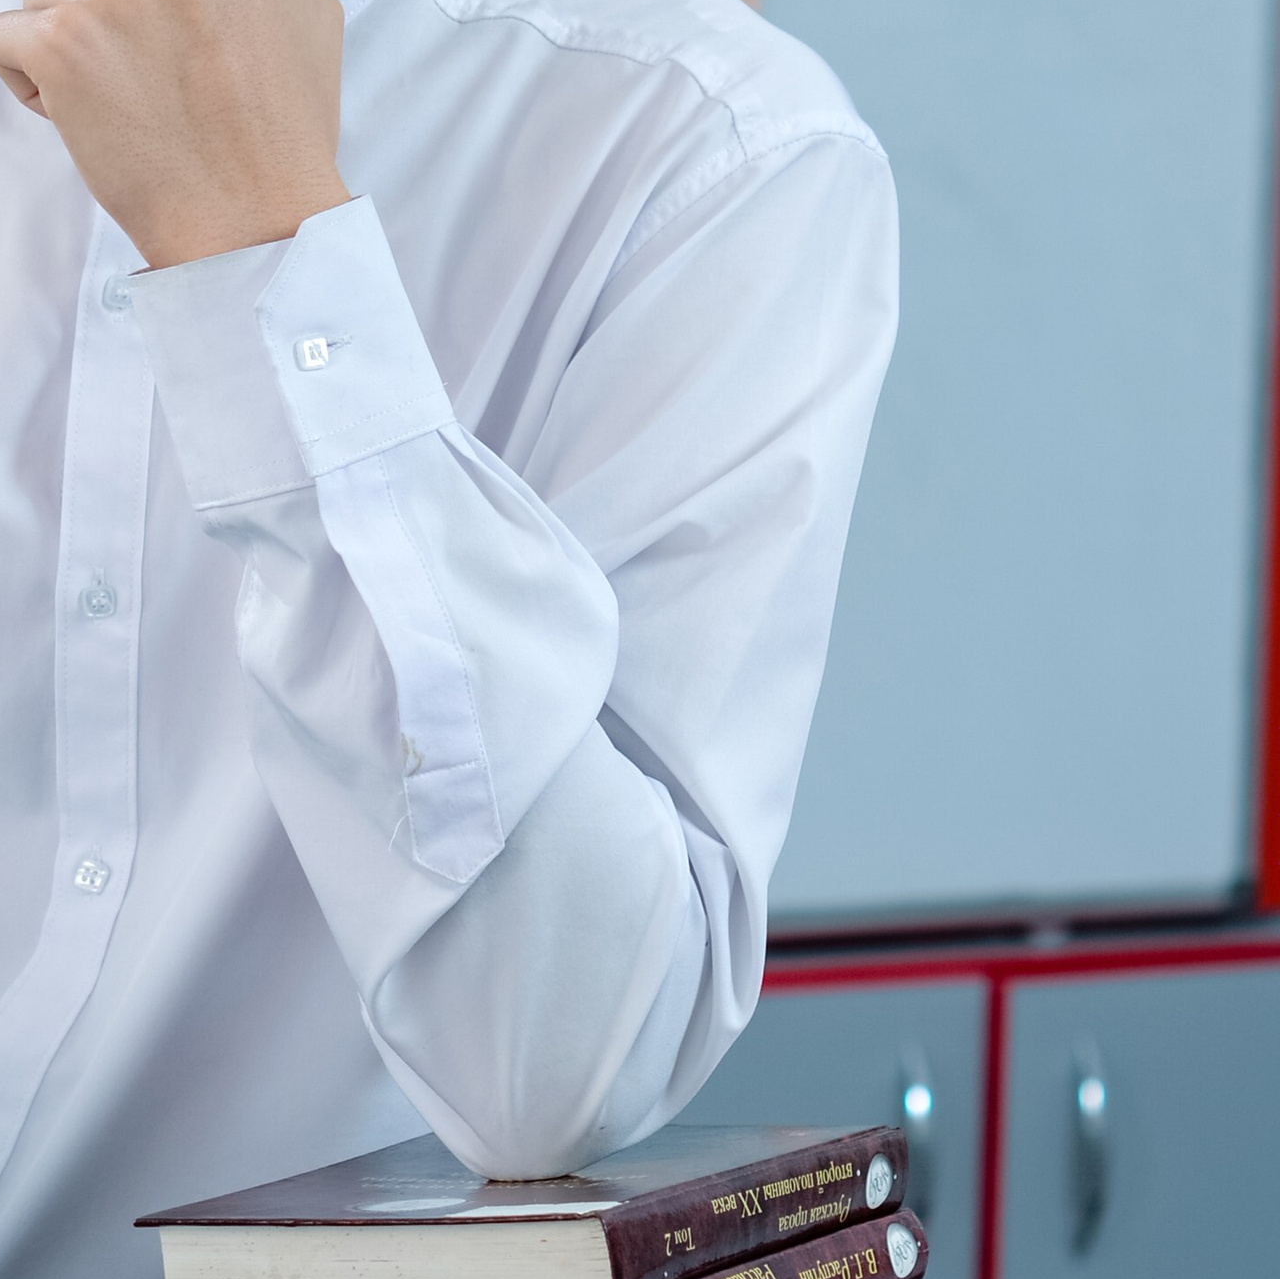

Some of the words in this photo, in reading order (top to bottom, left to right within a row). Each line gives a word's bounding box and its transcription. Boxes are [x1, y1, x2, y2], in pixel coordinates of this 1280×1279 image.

[764, 1176, 814, 1201] половины
[816, 1161, 853, 1194] второй
[711, 1194, 737, 1215] века
[809, 1194, 852, 1223] Русская
[778, 1204, 808, 1232] проза
[664, 1232, 672, 1257] 2
[675, 1227, 696, 1251] Том
